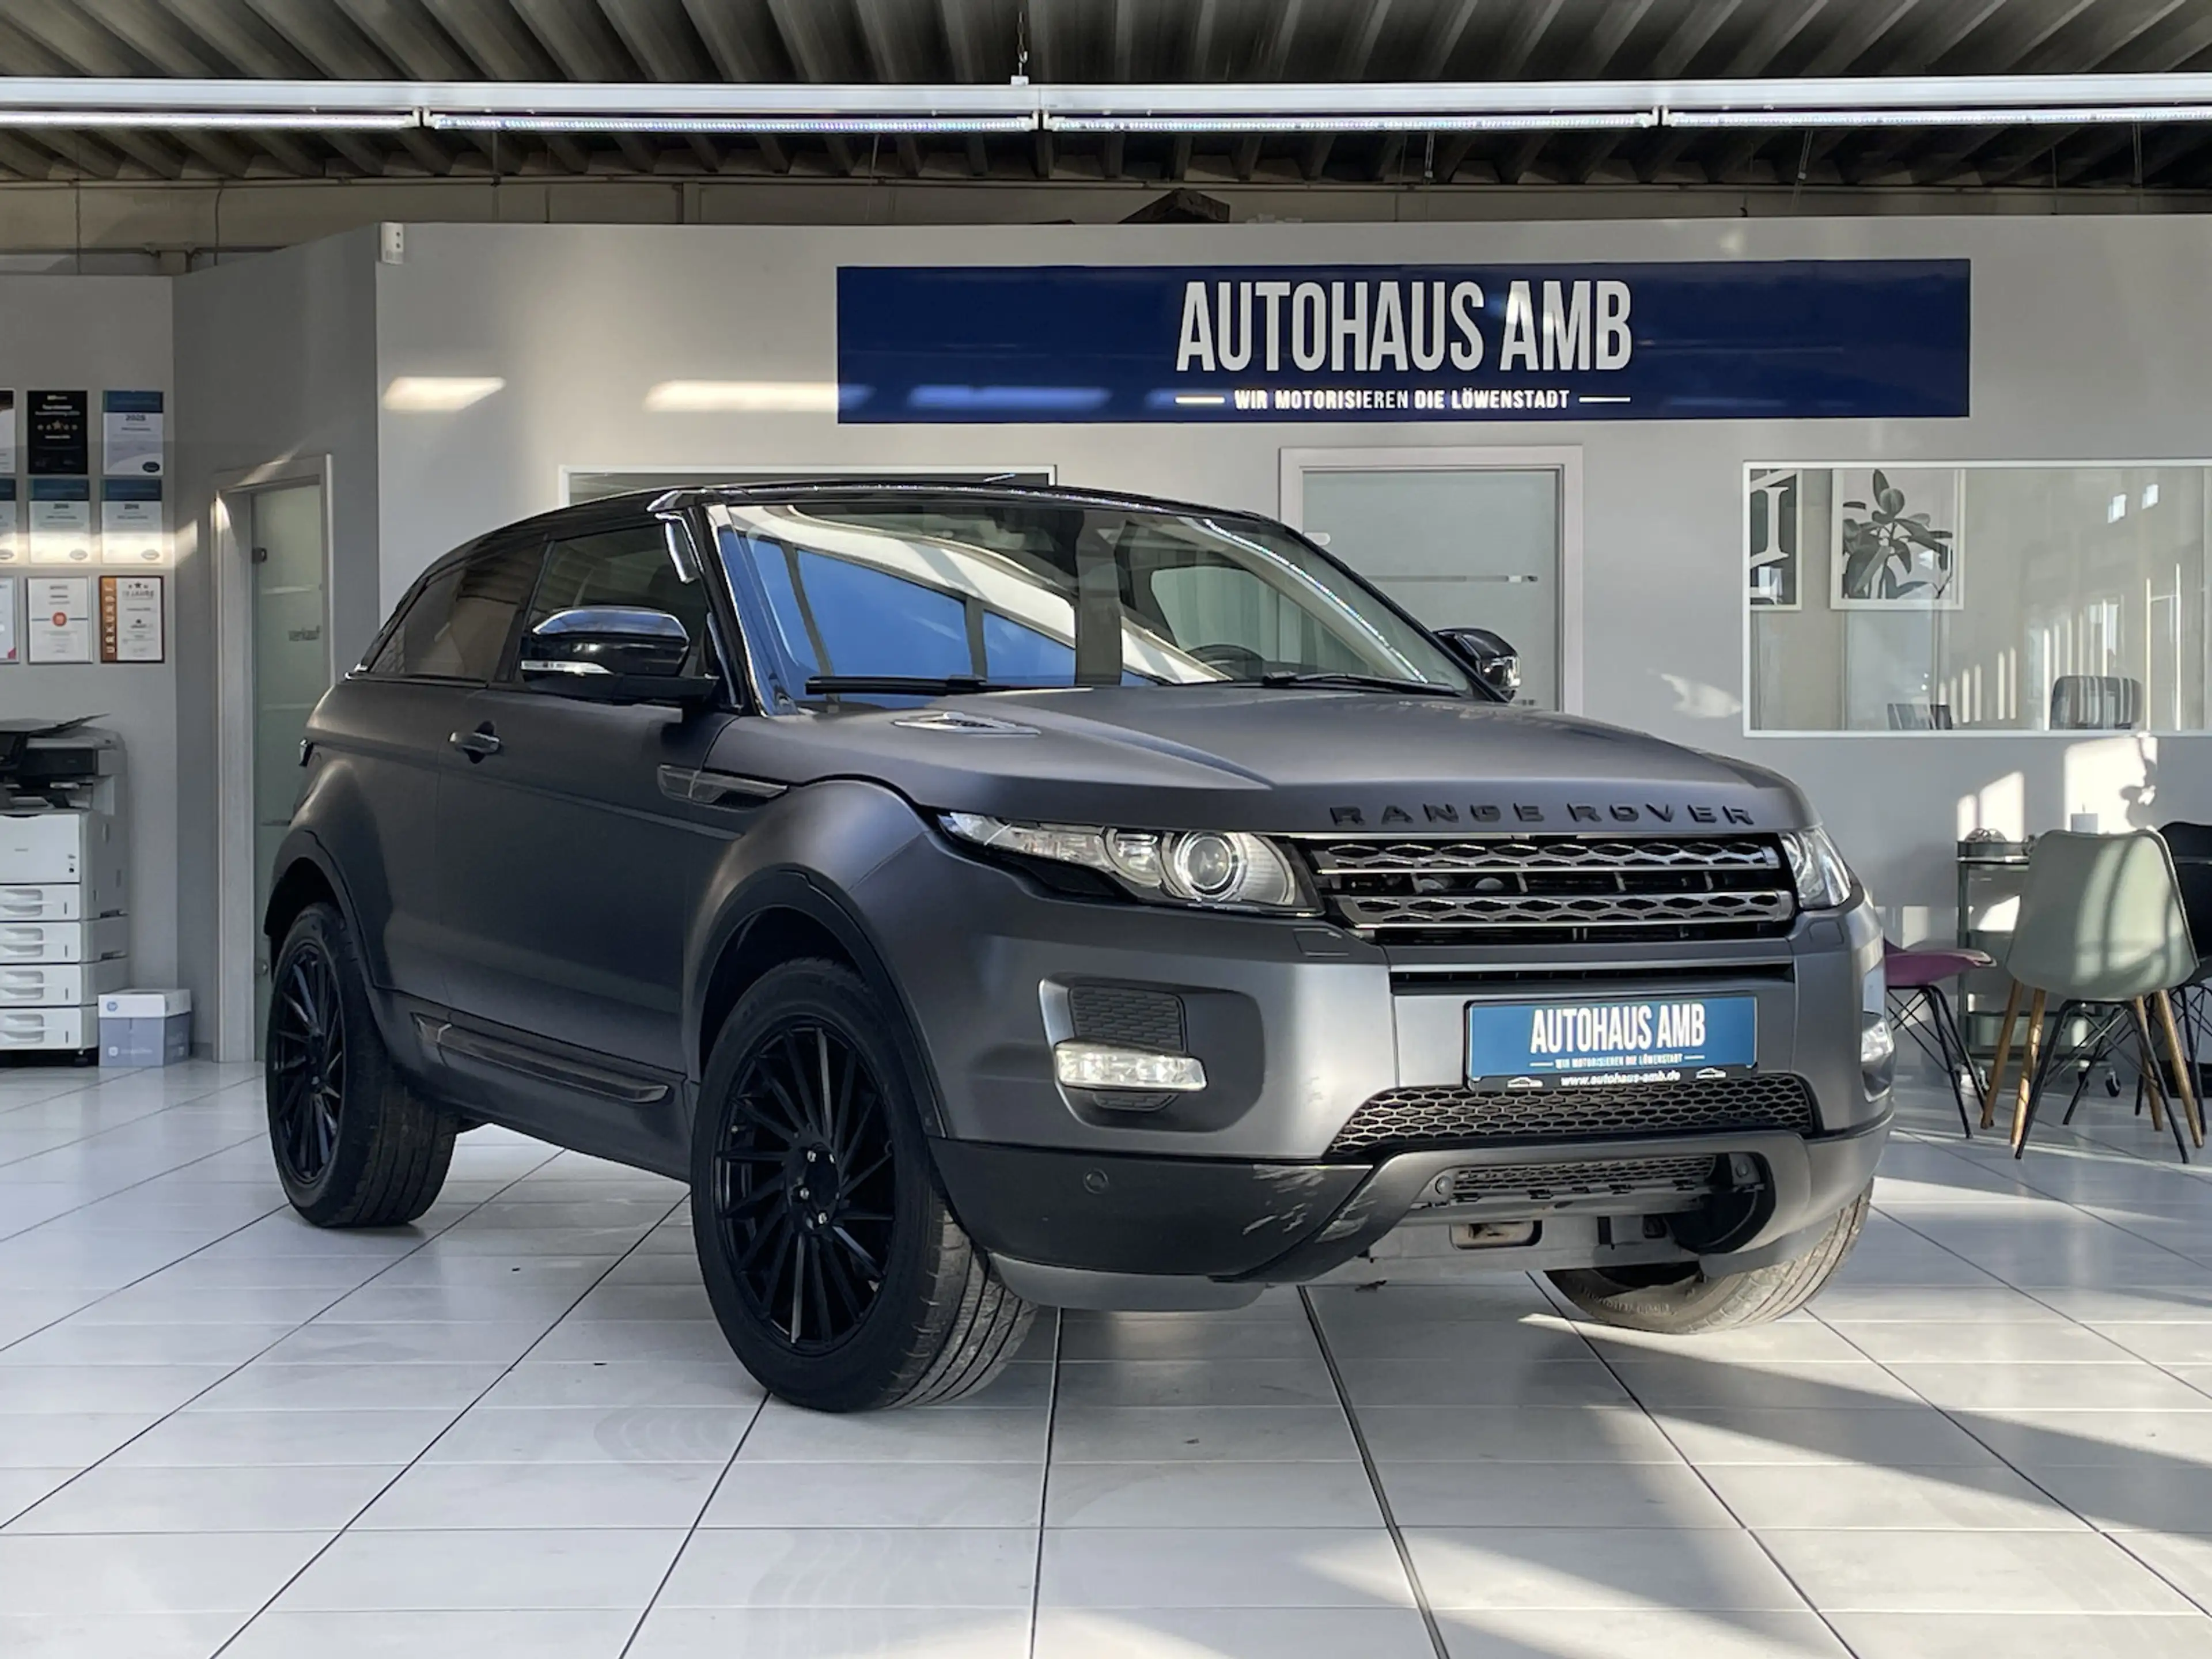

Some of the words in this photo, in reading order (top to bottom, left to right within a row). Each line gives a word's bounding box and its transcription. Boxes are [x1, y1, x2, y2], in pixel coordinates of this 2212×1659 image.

[1176, 280, 1484, 372] AUTOHAUS
[1499, 280, 1632, 372] AMB
[1234, 389, 1267, 410] WIR
[1274, 389, 1409, 410] MOTORISIEREN
[1414, 389, 1445, 409] DIE
[1451, 388, 1570, 410] LÖWENSTADT
[1330, 802, 1546, 826] RANGE
[1566, 802, 1755, 825] ROVER
[1530, 1005, 1653, 1054] AUTOHAUS
[1657, 1003, 1705, 1048] AMB
[1560, 1070, 1681, 1086] www.autohaus-amb.de
